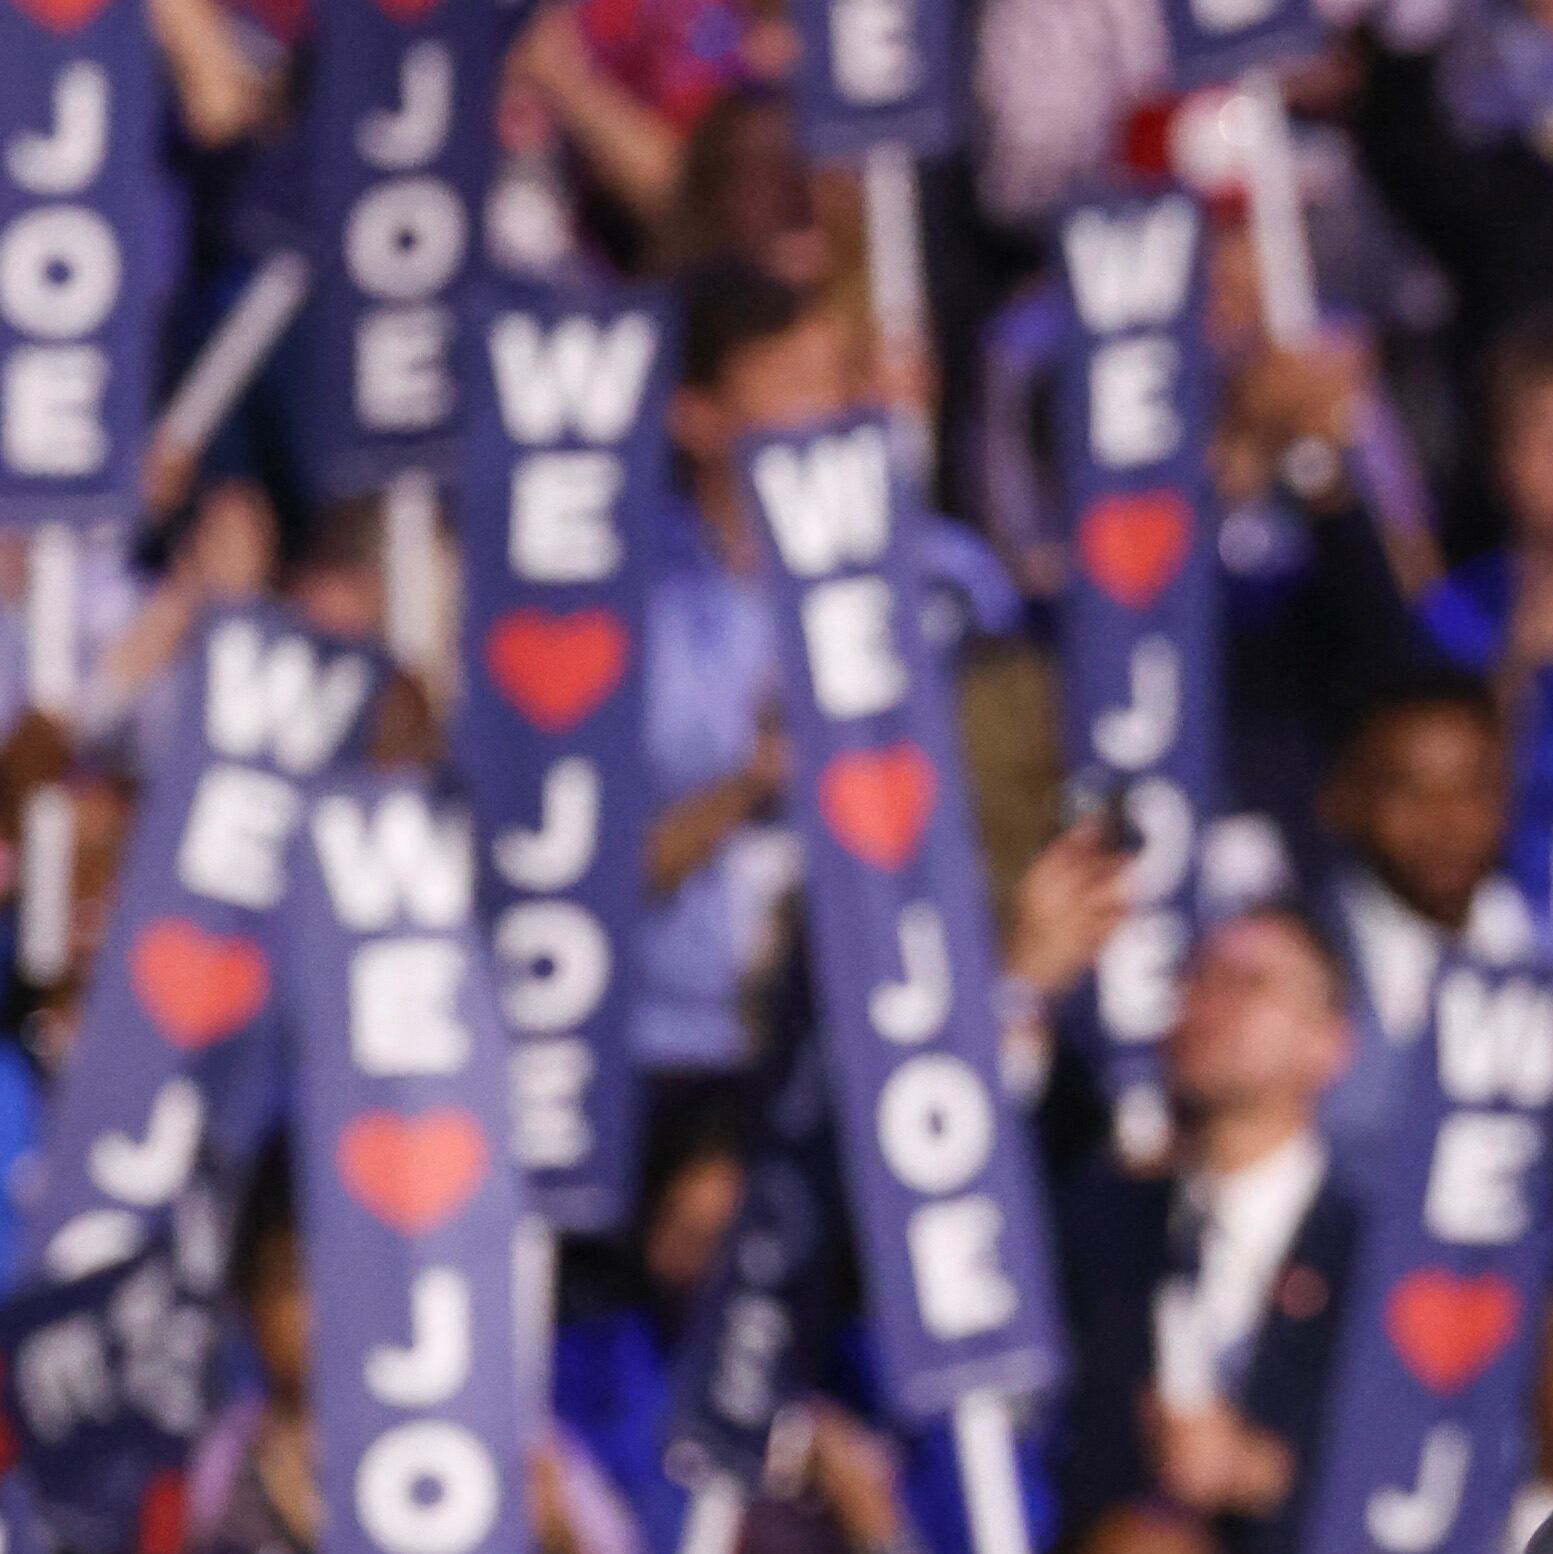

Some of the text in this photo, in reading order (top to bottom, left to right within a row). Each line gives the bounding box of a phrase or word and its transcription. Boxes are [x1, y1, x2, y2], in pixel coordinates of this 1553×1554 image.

[0, 58, 122, 476] JOE
[344, 40, 468, 431] JOE
[1062, 196, 1198, 470] WE
[177, 617, 376, 913] WE
[309, 789, 478, 1077] WE
[487, 311, 660, 1170] WE JOE
[754, 421, 1020, 1341] WE JOE
